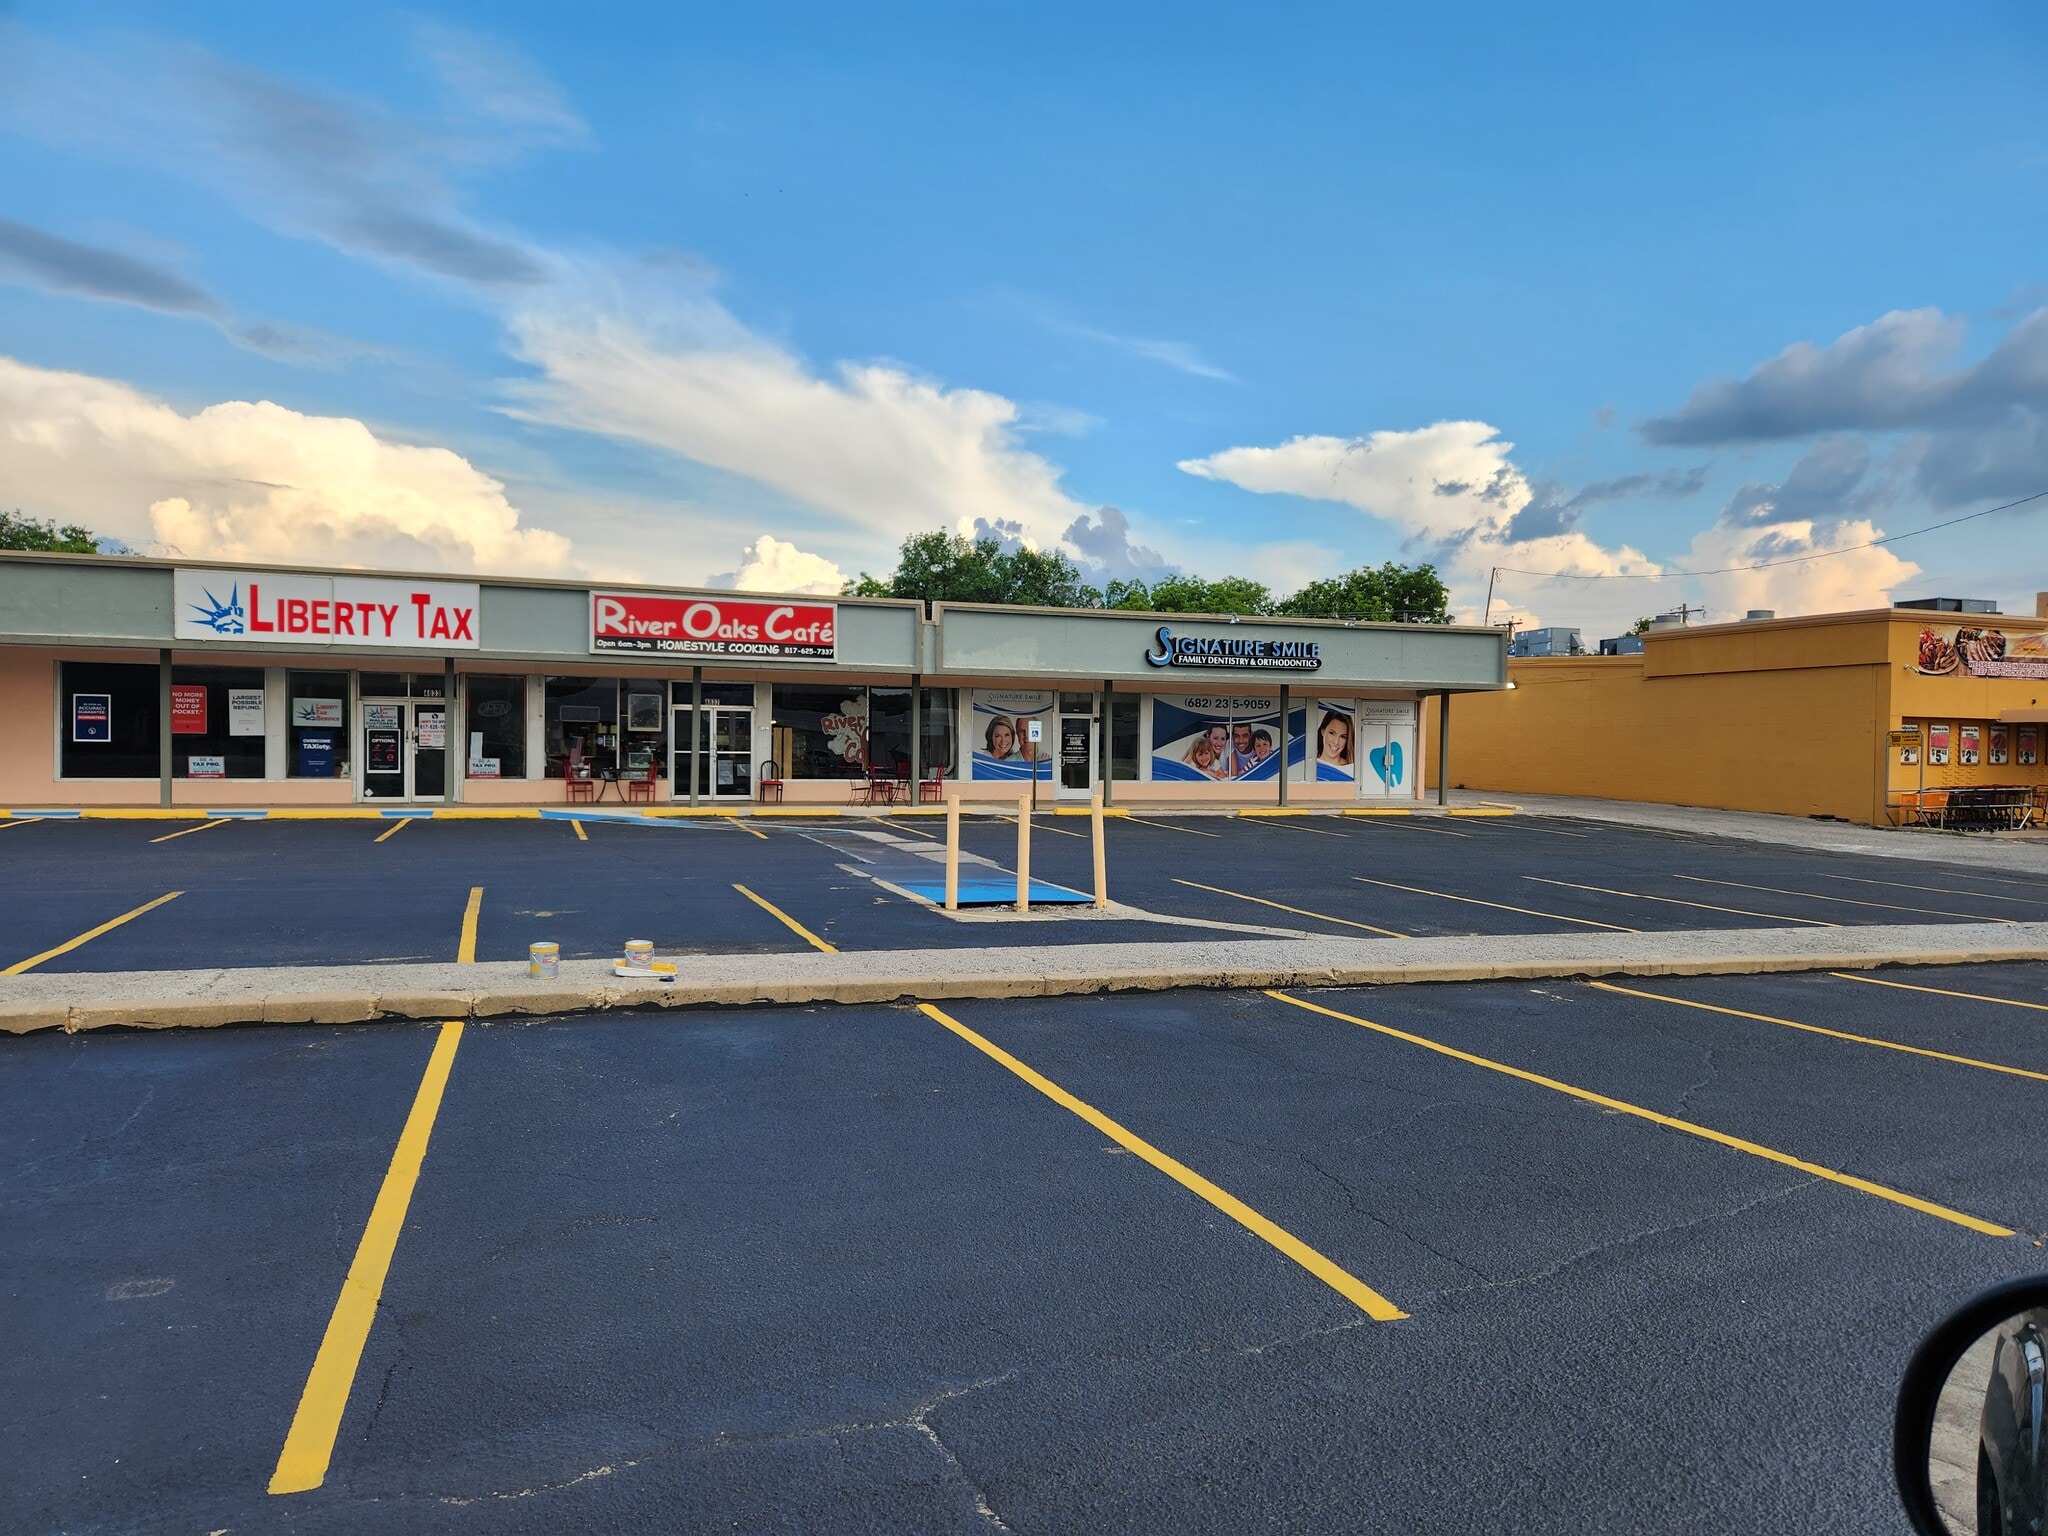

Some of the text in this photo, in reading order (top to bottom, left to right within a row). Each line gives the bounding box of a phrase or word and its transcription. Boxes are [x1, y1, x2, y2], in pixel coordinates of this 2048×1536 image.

[249, 584, 473, 640] LIBERTY TAX
[597, 598, 834, 643] River Oaks Café
[597, 639, 616, 648] Open
[618, 640, 652, 650] 6am-3pm
[657, 639, 725, 653] HOMESTYLE
[729, 642, 780, 655] COOKING
[1272, 640, 1321, 658] SMILE
[1179, 655, 1318, 668] FAMILY DENTISTRY & ORTHODONTICS
[1184, 696, 1212, 708] (682)
[822, 715, 866, 732] River
